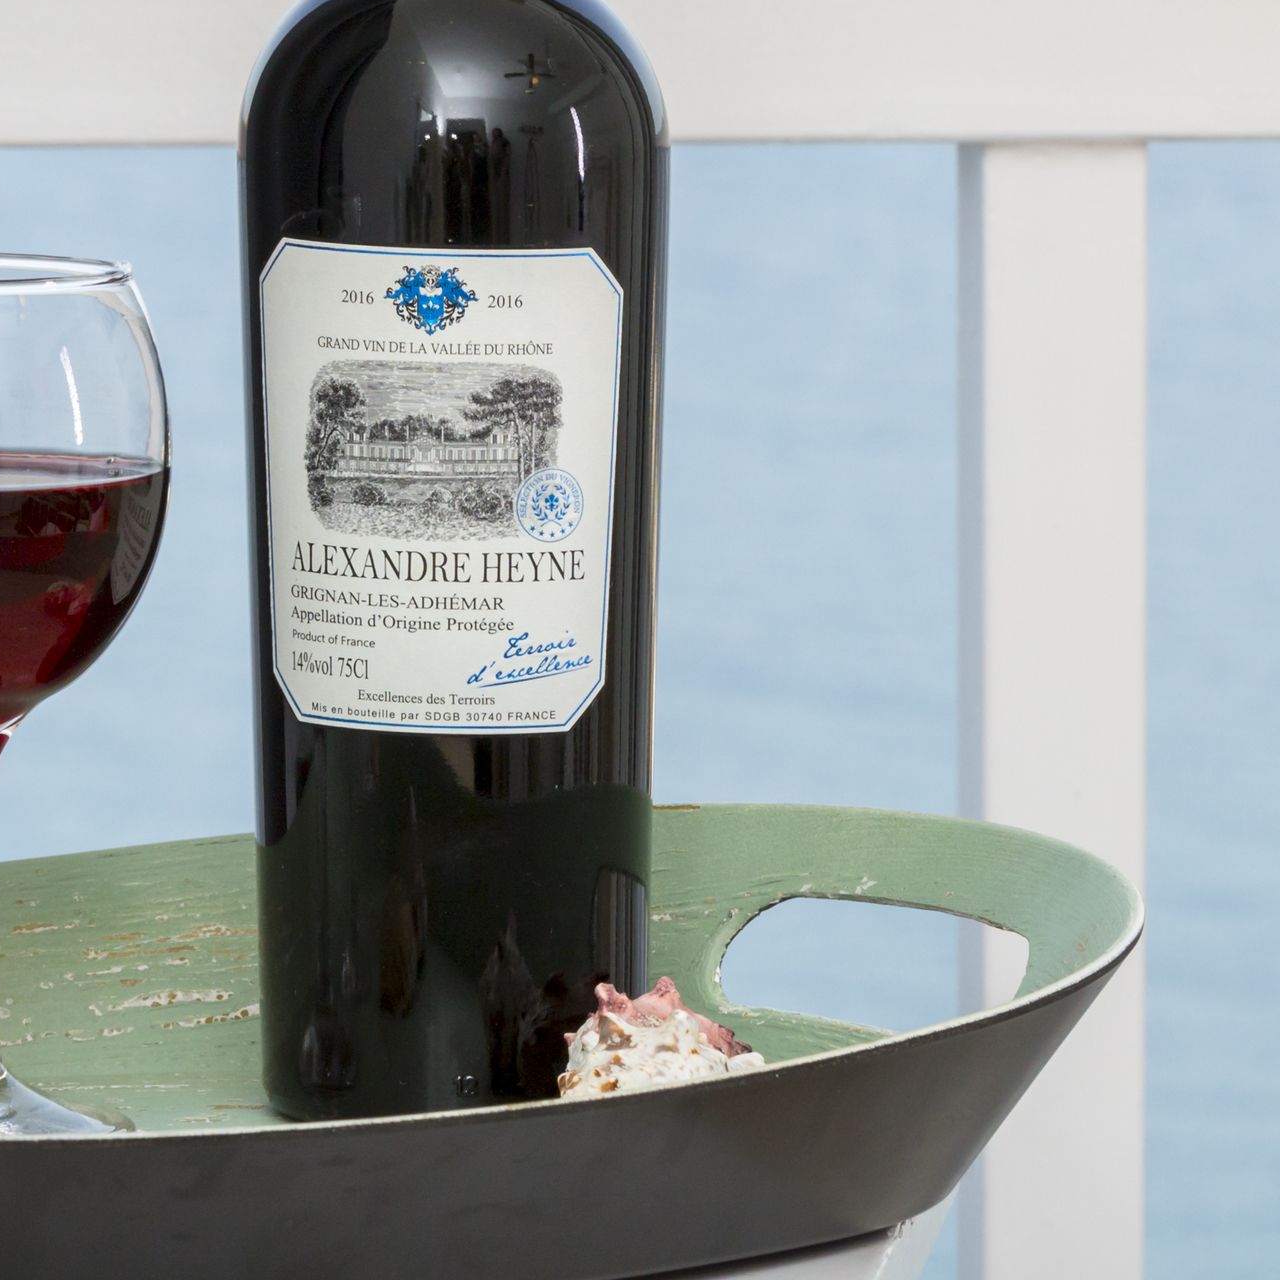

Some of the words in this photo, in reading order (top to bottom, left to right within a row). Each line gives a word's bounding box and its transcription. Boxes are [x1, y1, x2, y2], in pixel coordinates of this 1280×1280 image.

[341, 289, 375, 304] 2016
[487, 294, 524, 309] 2016
[317, 335, 360, 351] GRAND
[363, 340, 386, 352] VIN
[388, 341, 407, 353] DE
[409, 342, 428, 354] LA
[431, 340, 480, 356] VALLÉE
[484, 344, 504, 356] DU
[507, 340, 553, 355] RHÔNE
[545, 473, 558, 481] DU
[291, 540, 472, 583] ALEXANDRE
[481, 549, 586, 583] HEYNE
[290, 584, 505, 611] GRIGNAN-LES-ADHÉMAR
[290, 606, 363, 627] Appellation
[367, 613, 441, 634] d'Origine
[447, 618, 515, 634] Protégée
[292, 629, 325, 644] Product
[328, 634, 338, 645] of
[341, 636, 376, 648] France
[503, 630, 577, 659] Terroir
[292, 651, 333, 676] 14%vol
[338, 657, 369, 680] 75Cl
[357, 689, 423, 704] Excellences
[426, 693, 446, 705] des
[449, 693, 496, 705] Terroirs
[311, 702, 328, 713] Mis
[331, 706, 343, 715] en
[347, 706, 396, 719] bouteille
[400, 712, 420, 721] par
[424, 712, 461, 721] SDGB
[465, 712, 503, 721] 30740
[507, 710, 557, 720] FRANCE
